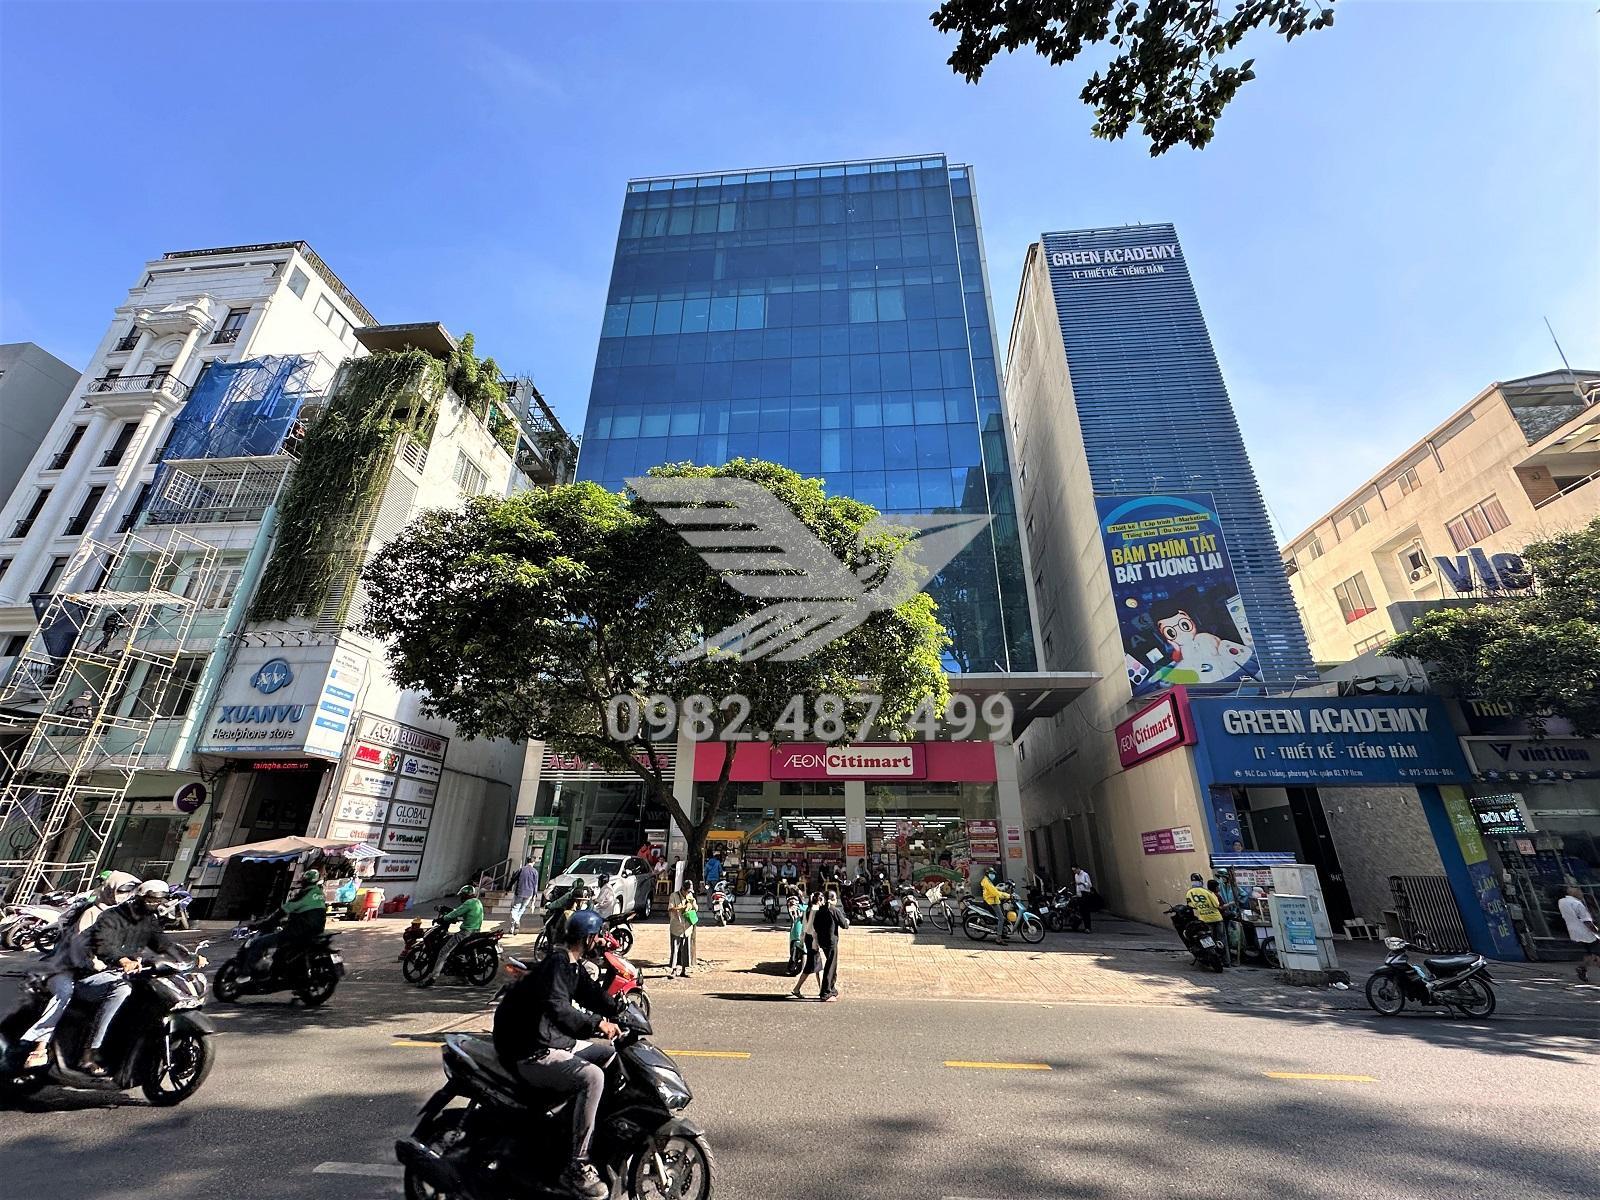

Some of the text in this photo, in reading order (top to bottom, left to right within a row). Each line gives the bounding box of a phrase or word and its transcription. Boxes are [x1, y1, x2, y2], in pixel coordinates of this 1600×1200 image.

[1052, 245, 1176, 267] GREEN ACADEMY
[1200, 552, 1224, 571] LAI
[1134, 713, 1173, 745] Citimart
[1222, 708, 1429, 735] GREEN ACADEMY
[212, 727, 295, 742] Headphone store
[401, 730, 442, 752] BUILDING
[1254, 747, 1266, 760] IT
[1278, 742, 1313, 759] THIẾT
[1318, 741, 1335, 759] KẾ
[1346, 741, 1386, 759] TIẾNG
[1388, 741, 1418, 758] HÀN
[827, 754, 911, 768] Citimart
[396, 805, 427, 820] GLOBAL
[397, 817, 423, 825] FASHION
